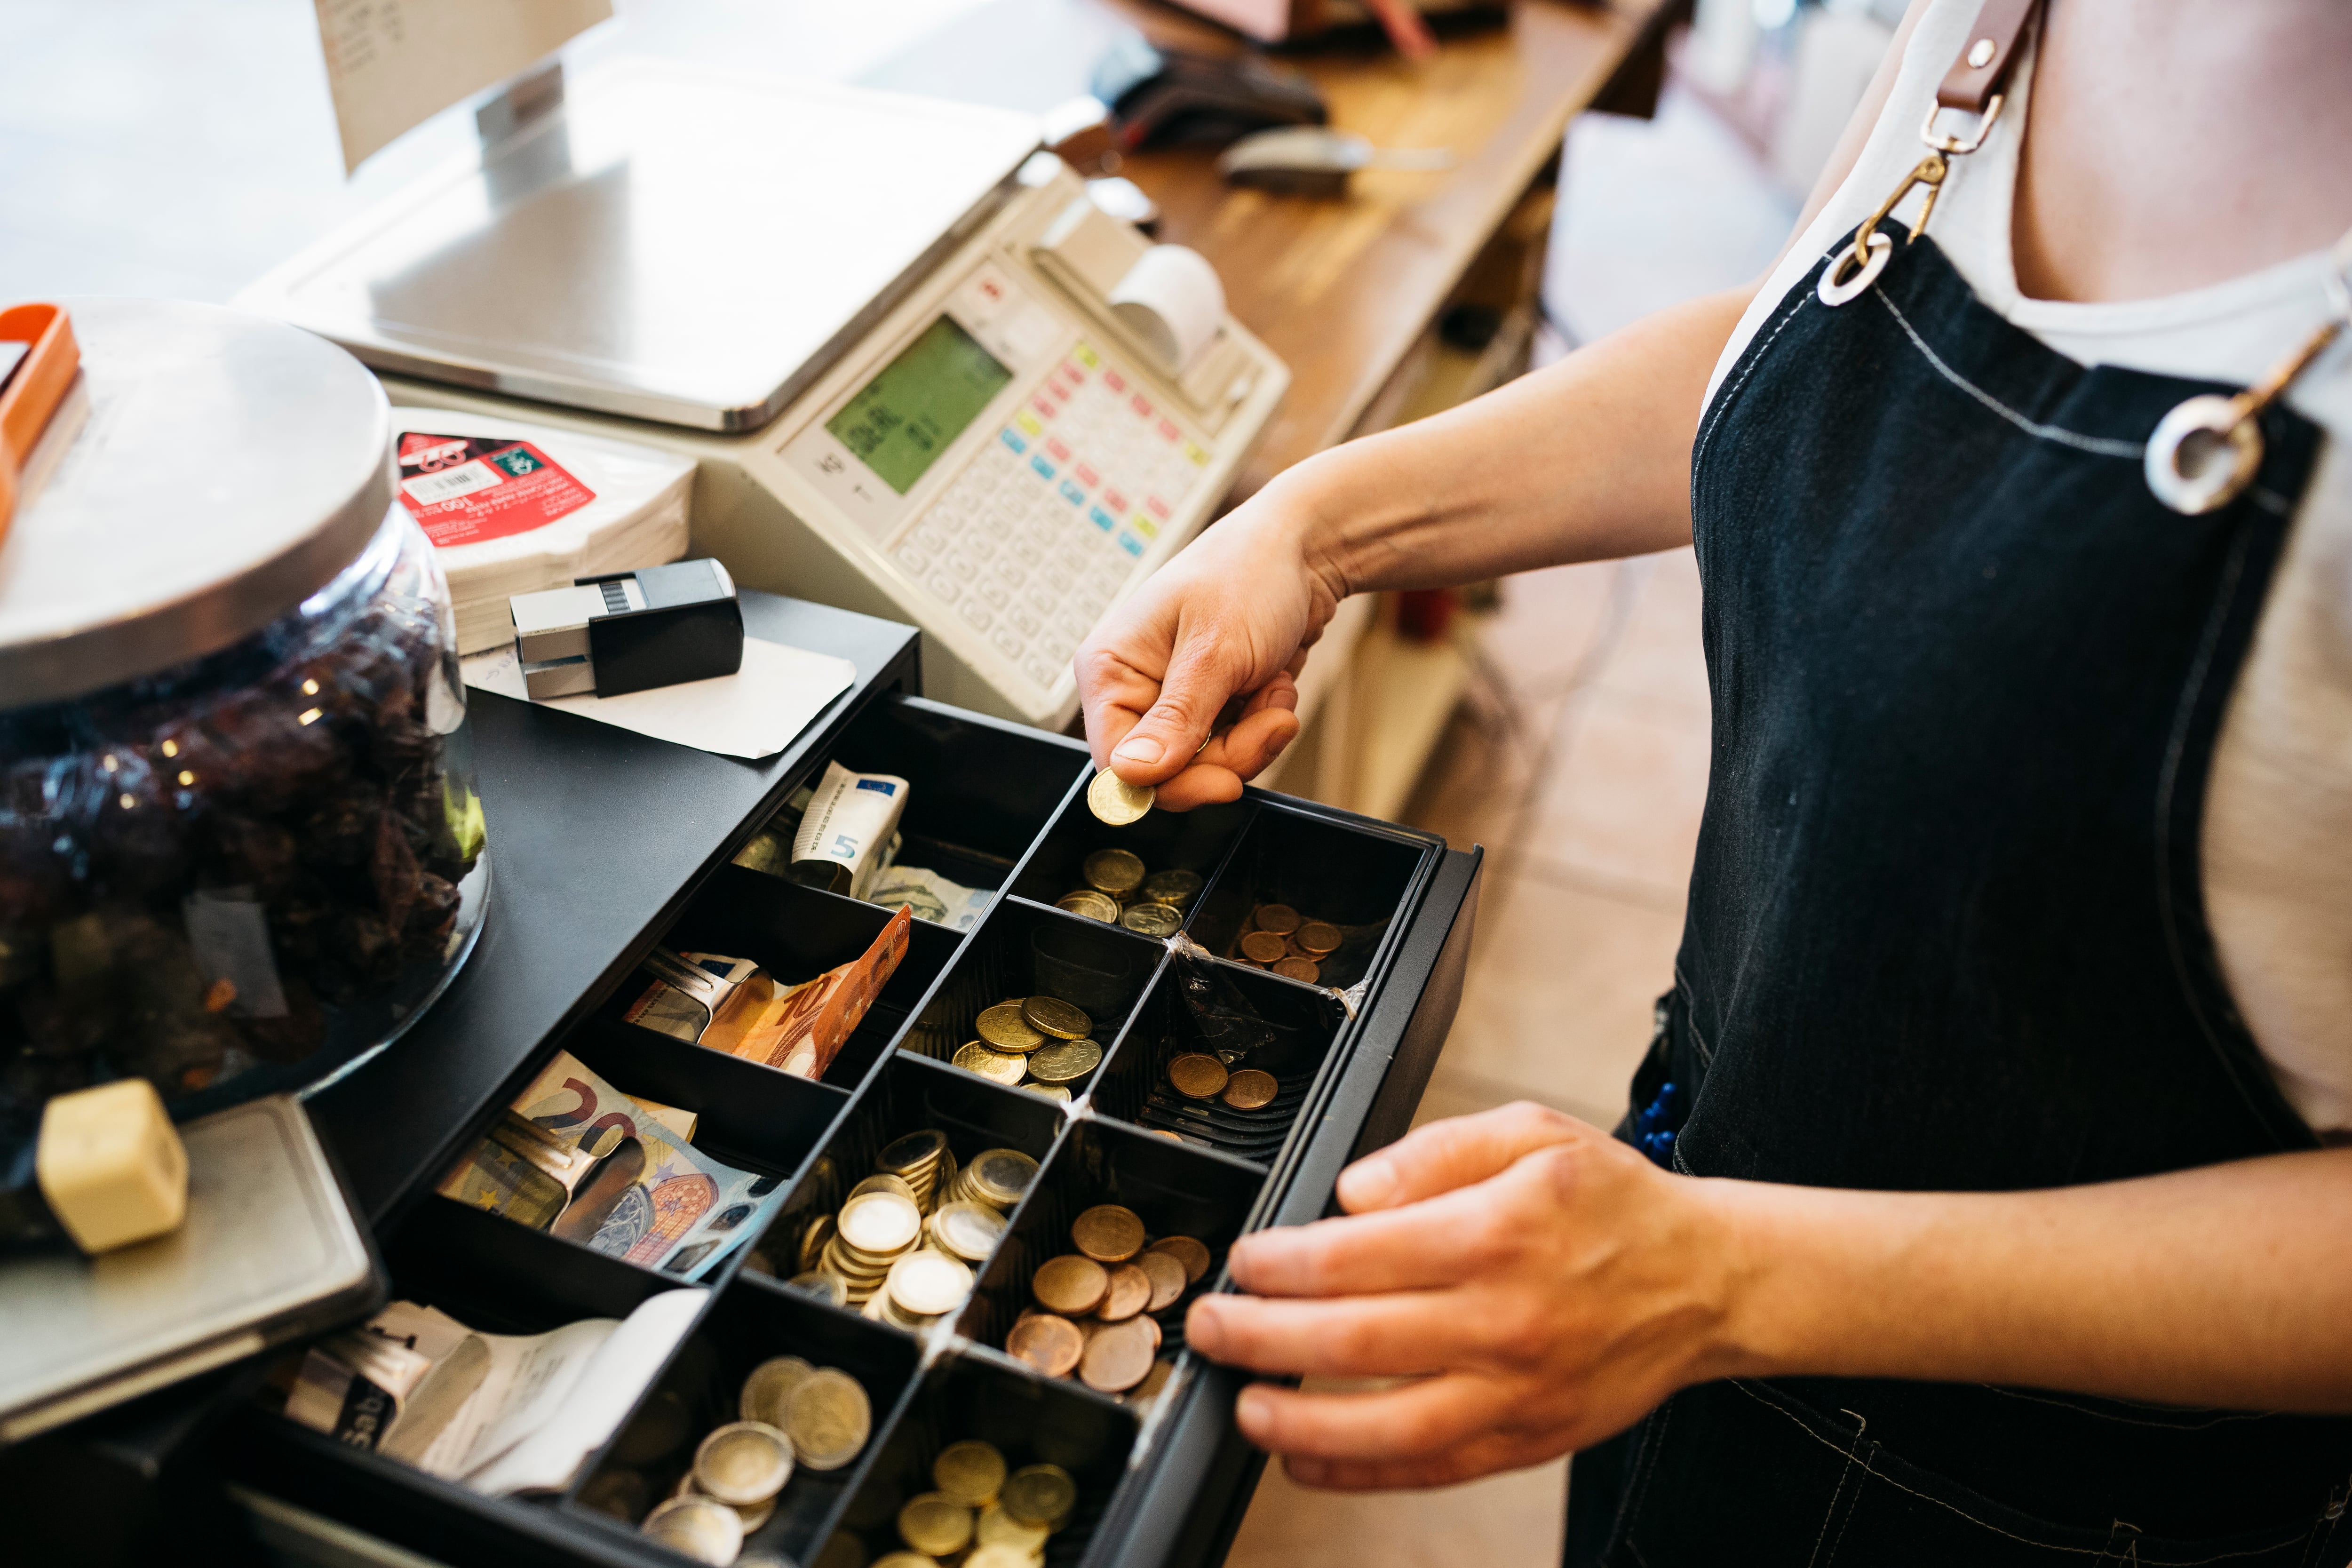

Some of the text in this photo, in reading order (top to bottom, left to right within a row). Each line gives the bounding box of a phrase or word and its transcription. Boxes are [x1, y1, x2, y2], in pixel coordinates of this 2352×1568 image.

[440, 495, 474, 512] 100
[830, 834, 858, 859] 5
[775, 976, 832, 1027] 10
[532, 1077, 636, 1154] 20
